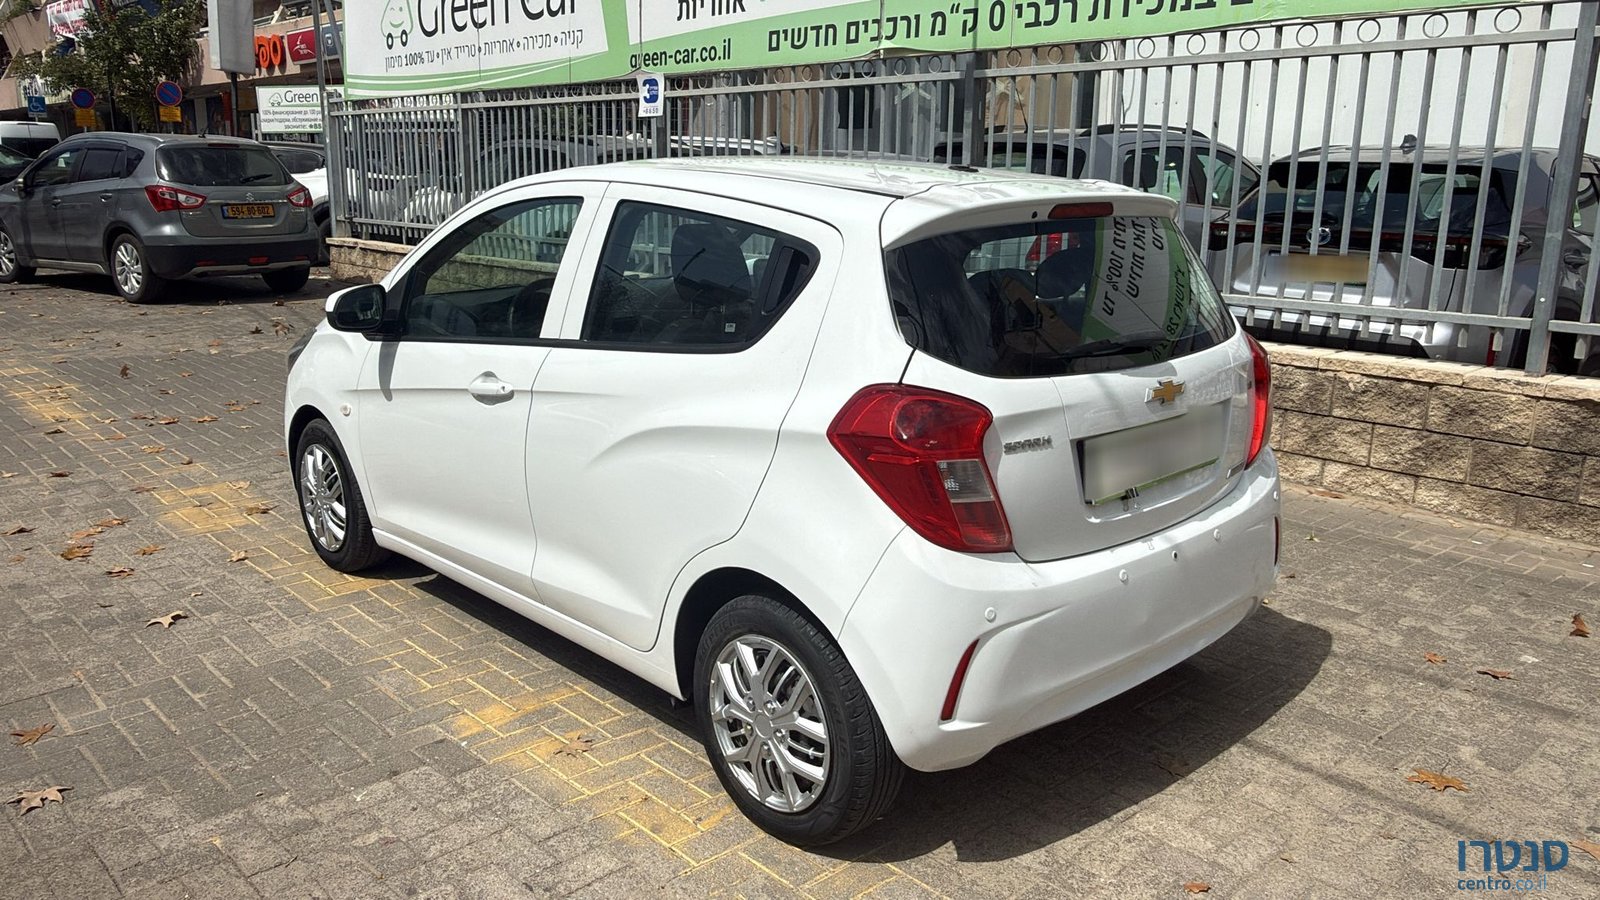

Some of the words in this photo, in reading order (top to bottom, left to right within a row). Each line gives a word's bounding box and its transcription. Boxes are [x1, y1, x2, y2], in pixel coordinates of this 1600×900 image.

[1015, 0, 1078, 28] רכבי
[768, 24, 837, 52] חדשים
[846, 14, 920, 44] ורכבים
[484, 38, 515, 55] אחריות
[523, 33, 551, 51] מכירה
[561, 29, 583, 49] קניה
[404, 52, 425, 66] 100%
[425, 50, 435, 63] עד
[441, 47, 452, 65] אין
[454, 44, 476, 59] טרייד
[385, 55, 403, 72] מימון
[284, 90, 319, 103] Green
[1003, 435, 1053, 455] SPARK
